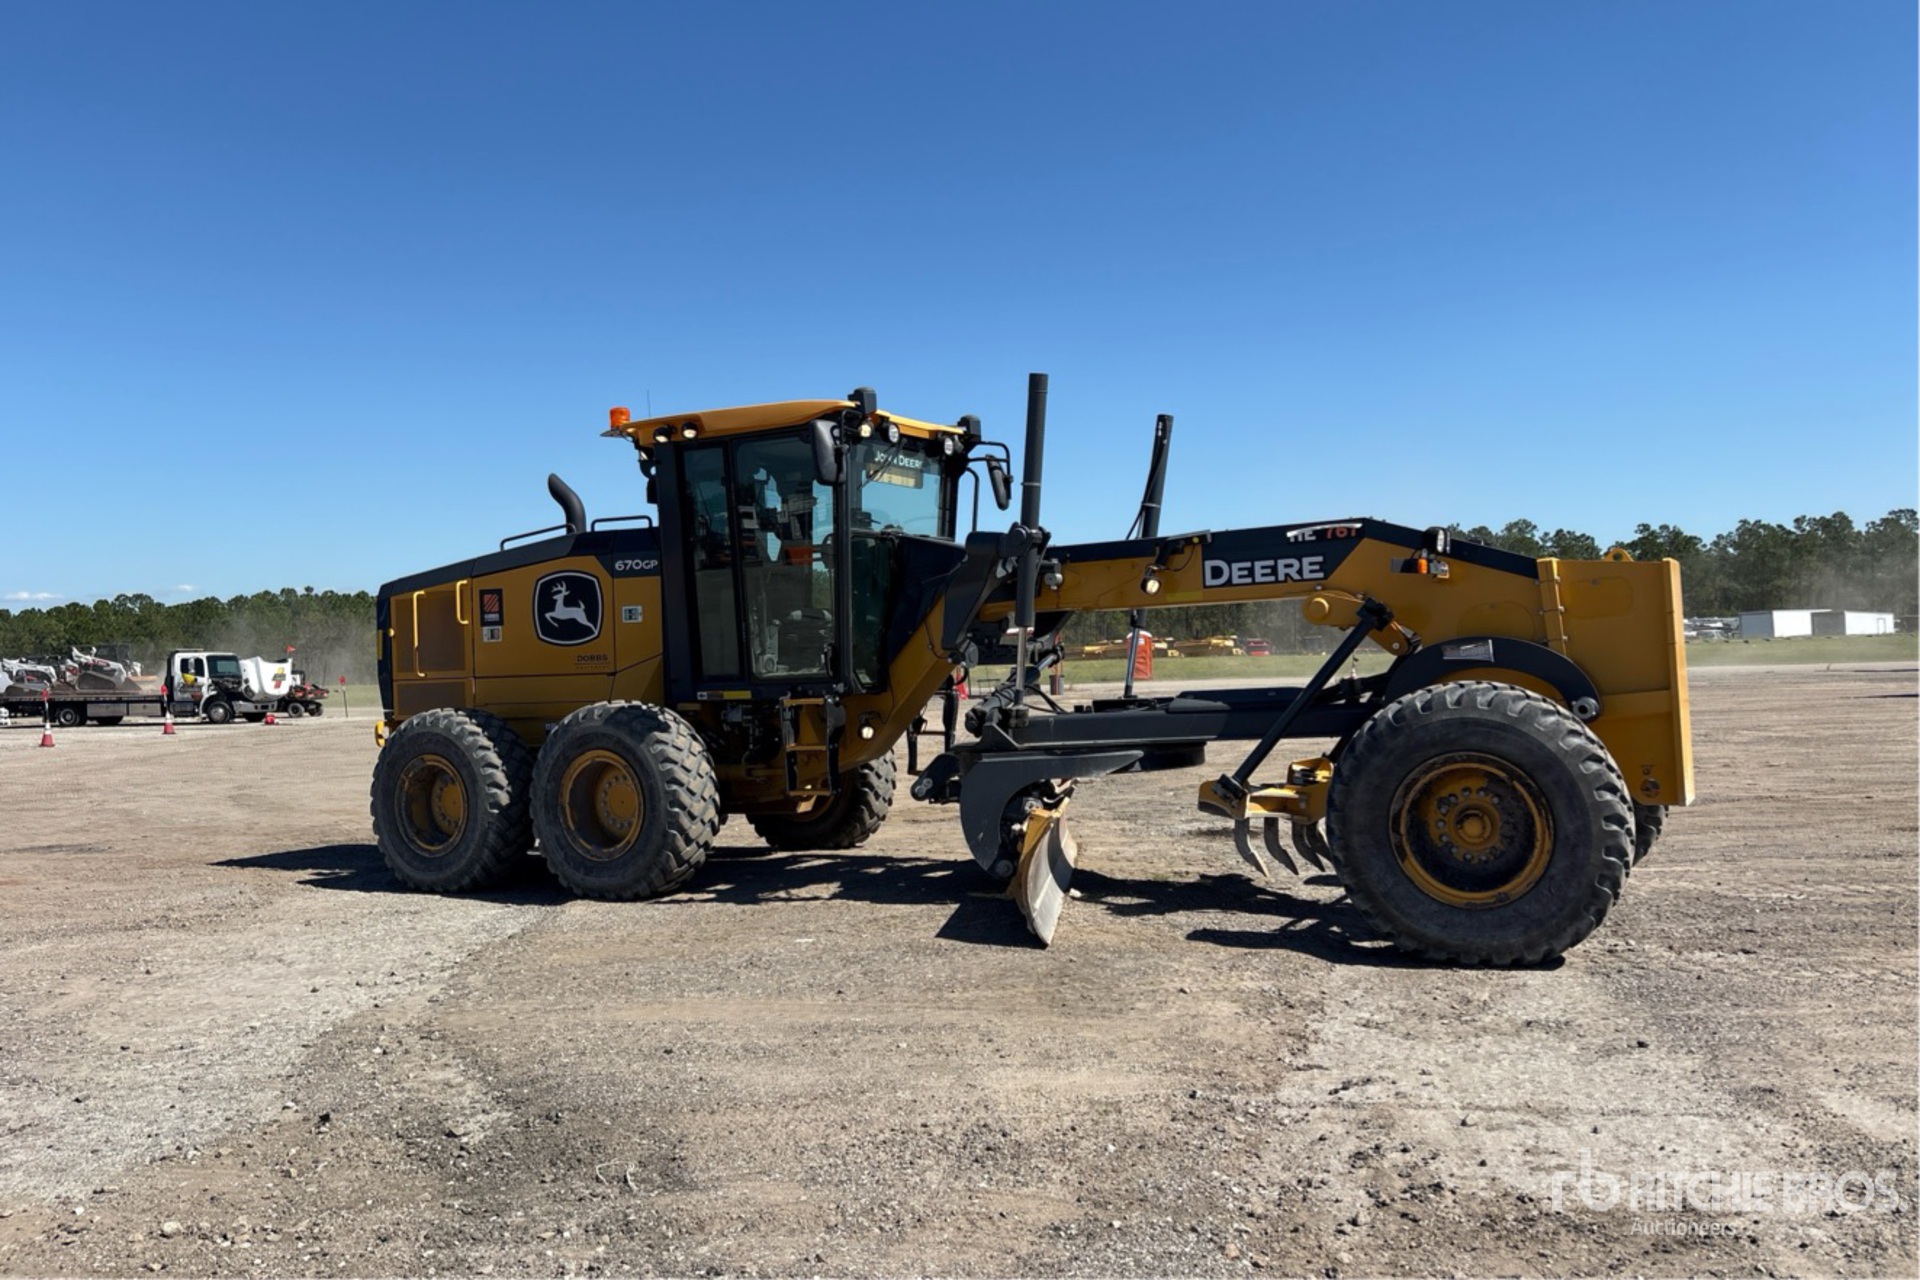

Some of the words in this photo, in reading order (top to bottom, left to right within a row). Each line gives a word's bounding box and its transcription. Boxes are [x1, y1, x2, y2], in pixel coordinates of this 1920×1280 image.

[874, 450, 897, 465] JO
[614, 559, 658, 571] 670GP
[1204, 556, 1324, 587] DEERE
[576, 654, 608, 662] DOBBS
